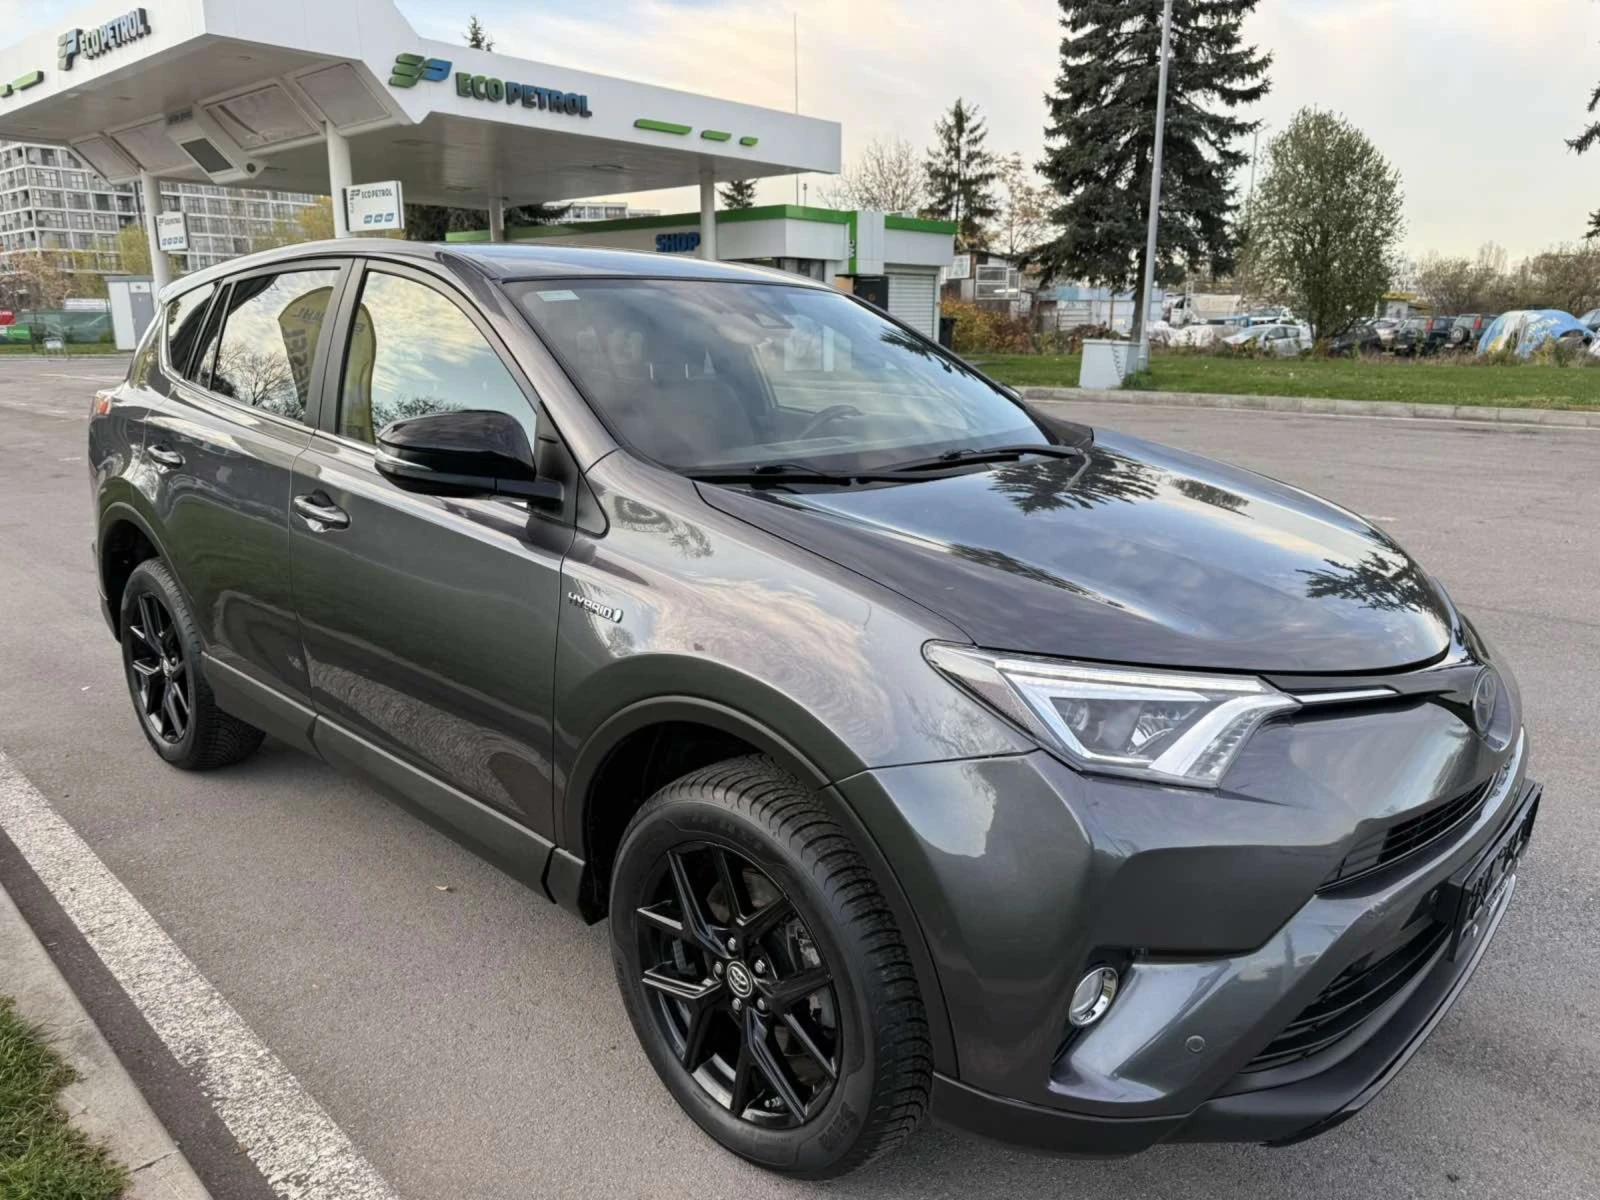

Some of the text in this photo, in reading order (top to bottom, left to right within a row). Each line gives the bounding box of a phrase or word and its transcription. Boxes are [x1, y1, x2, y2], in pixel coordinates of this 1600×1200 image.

[79, 8, 151, 59] ECOPETROL
[456, 72, 593, 118] ECOPETROL
[655, 231, 701, 252] SHOP
[567, 591, 613, 620] HYBRID
